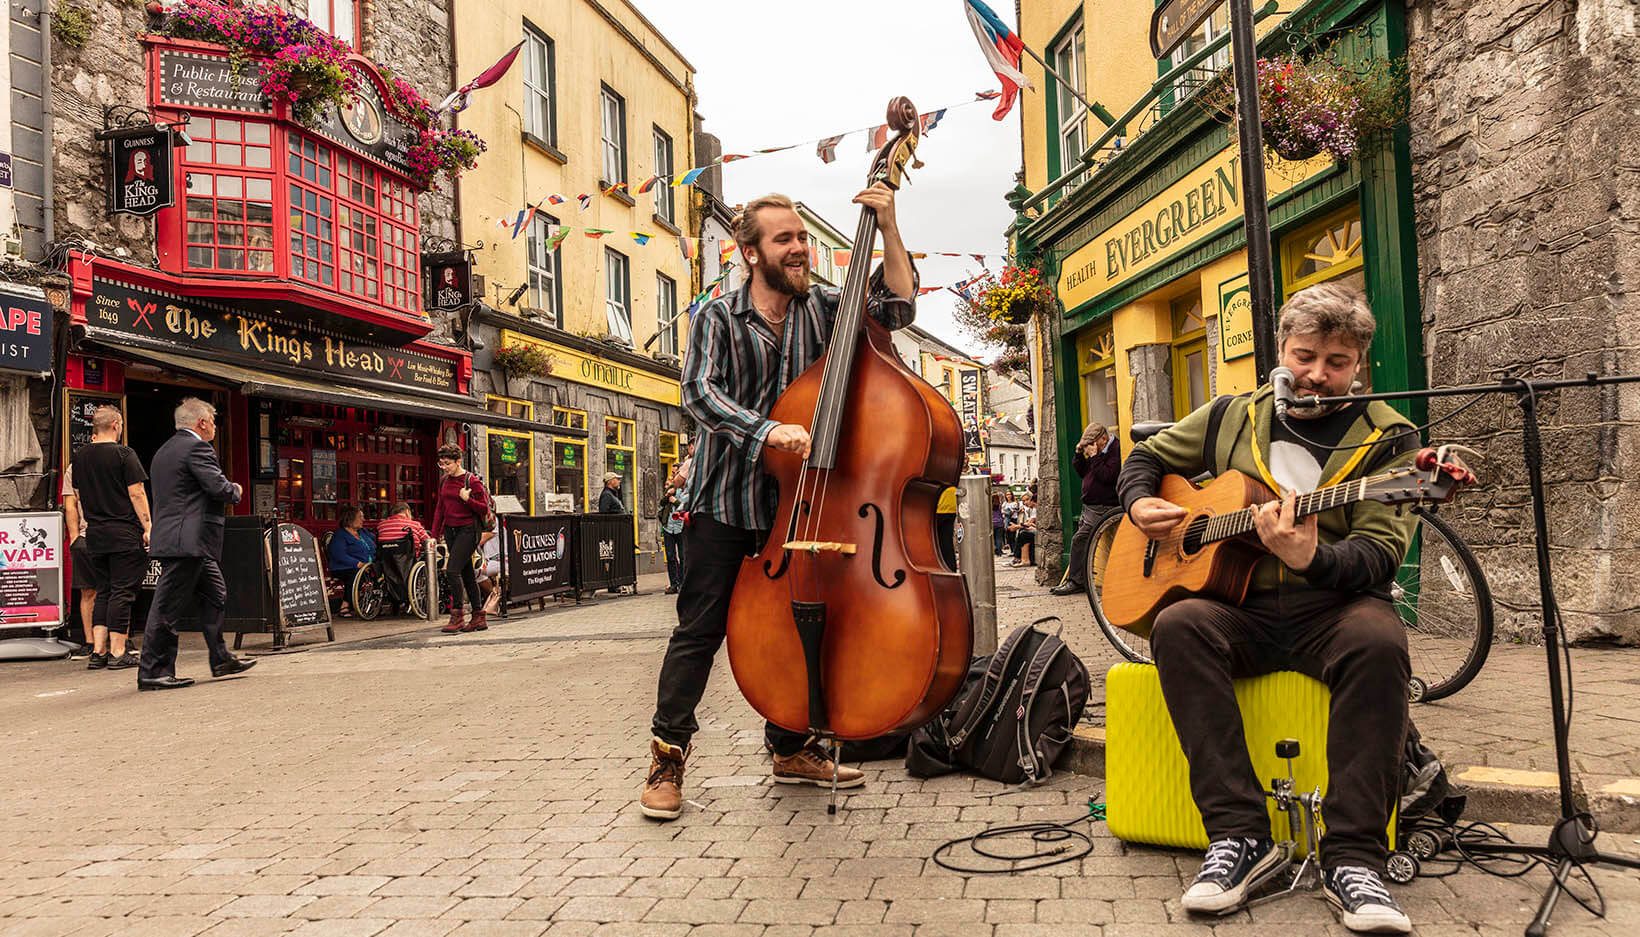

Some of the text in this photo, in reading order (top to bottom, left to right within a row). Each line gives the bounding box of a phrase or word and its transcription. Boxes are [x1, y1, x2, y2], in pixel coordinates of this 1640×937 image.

[173, 63, 261, 87] Public House
[170, 81, 263, 103] & Restaurant
[123, 137, 155, 149] GUINNESS
[124, 196, 156, 209] HEAD
[1105, 156, 1241, 282] EVERGREEN
[1066, 260, 1097, 291] HEALTH
[96, 294, 121, 308] Since
[437, 298, 461, 307] HEAD
[99, 308, 119, 325] 1649
[1225, 298, 1253, 332] EVERGRE
[165, 304, 384, 374] The Kings Head
[1226, 329, 1254, 348] CORNE
[522, 533, 556, 550] GUINNESS
[3, 548, 54, 563] VAPE
[522, 550, 557, 564] SIX NATIONS
